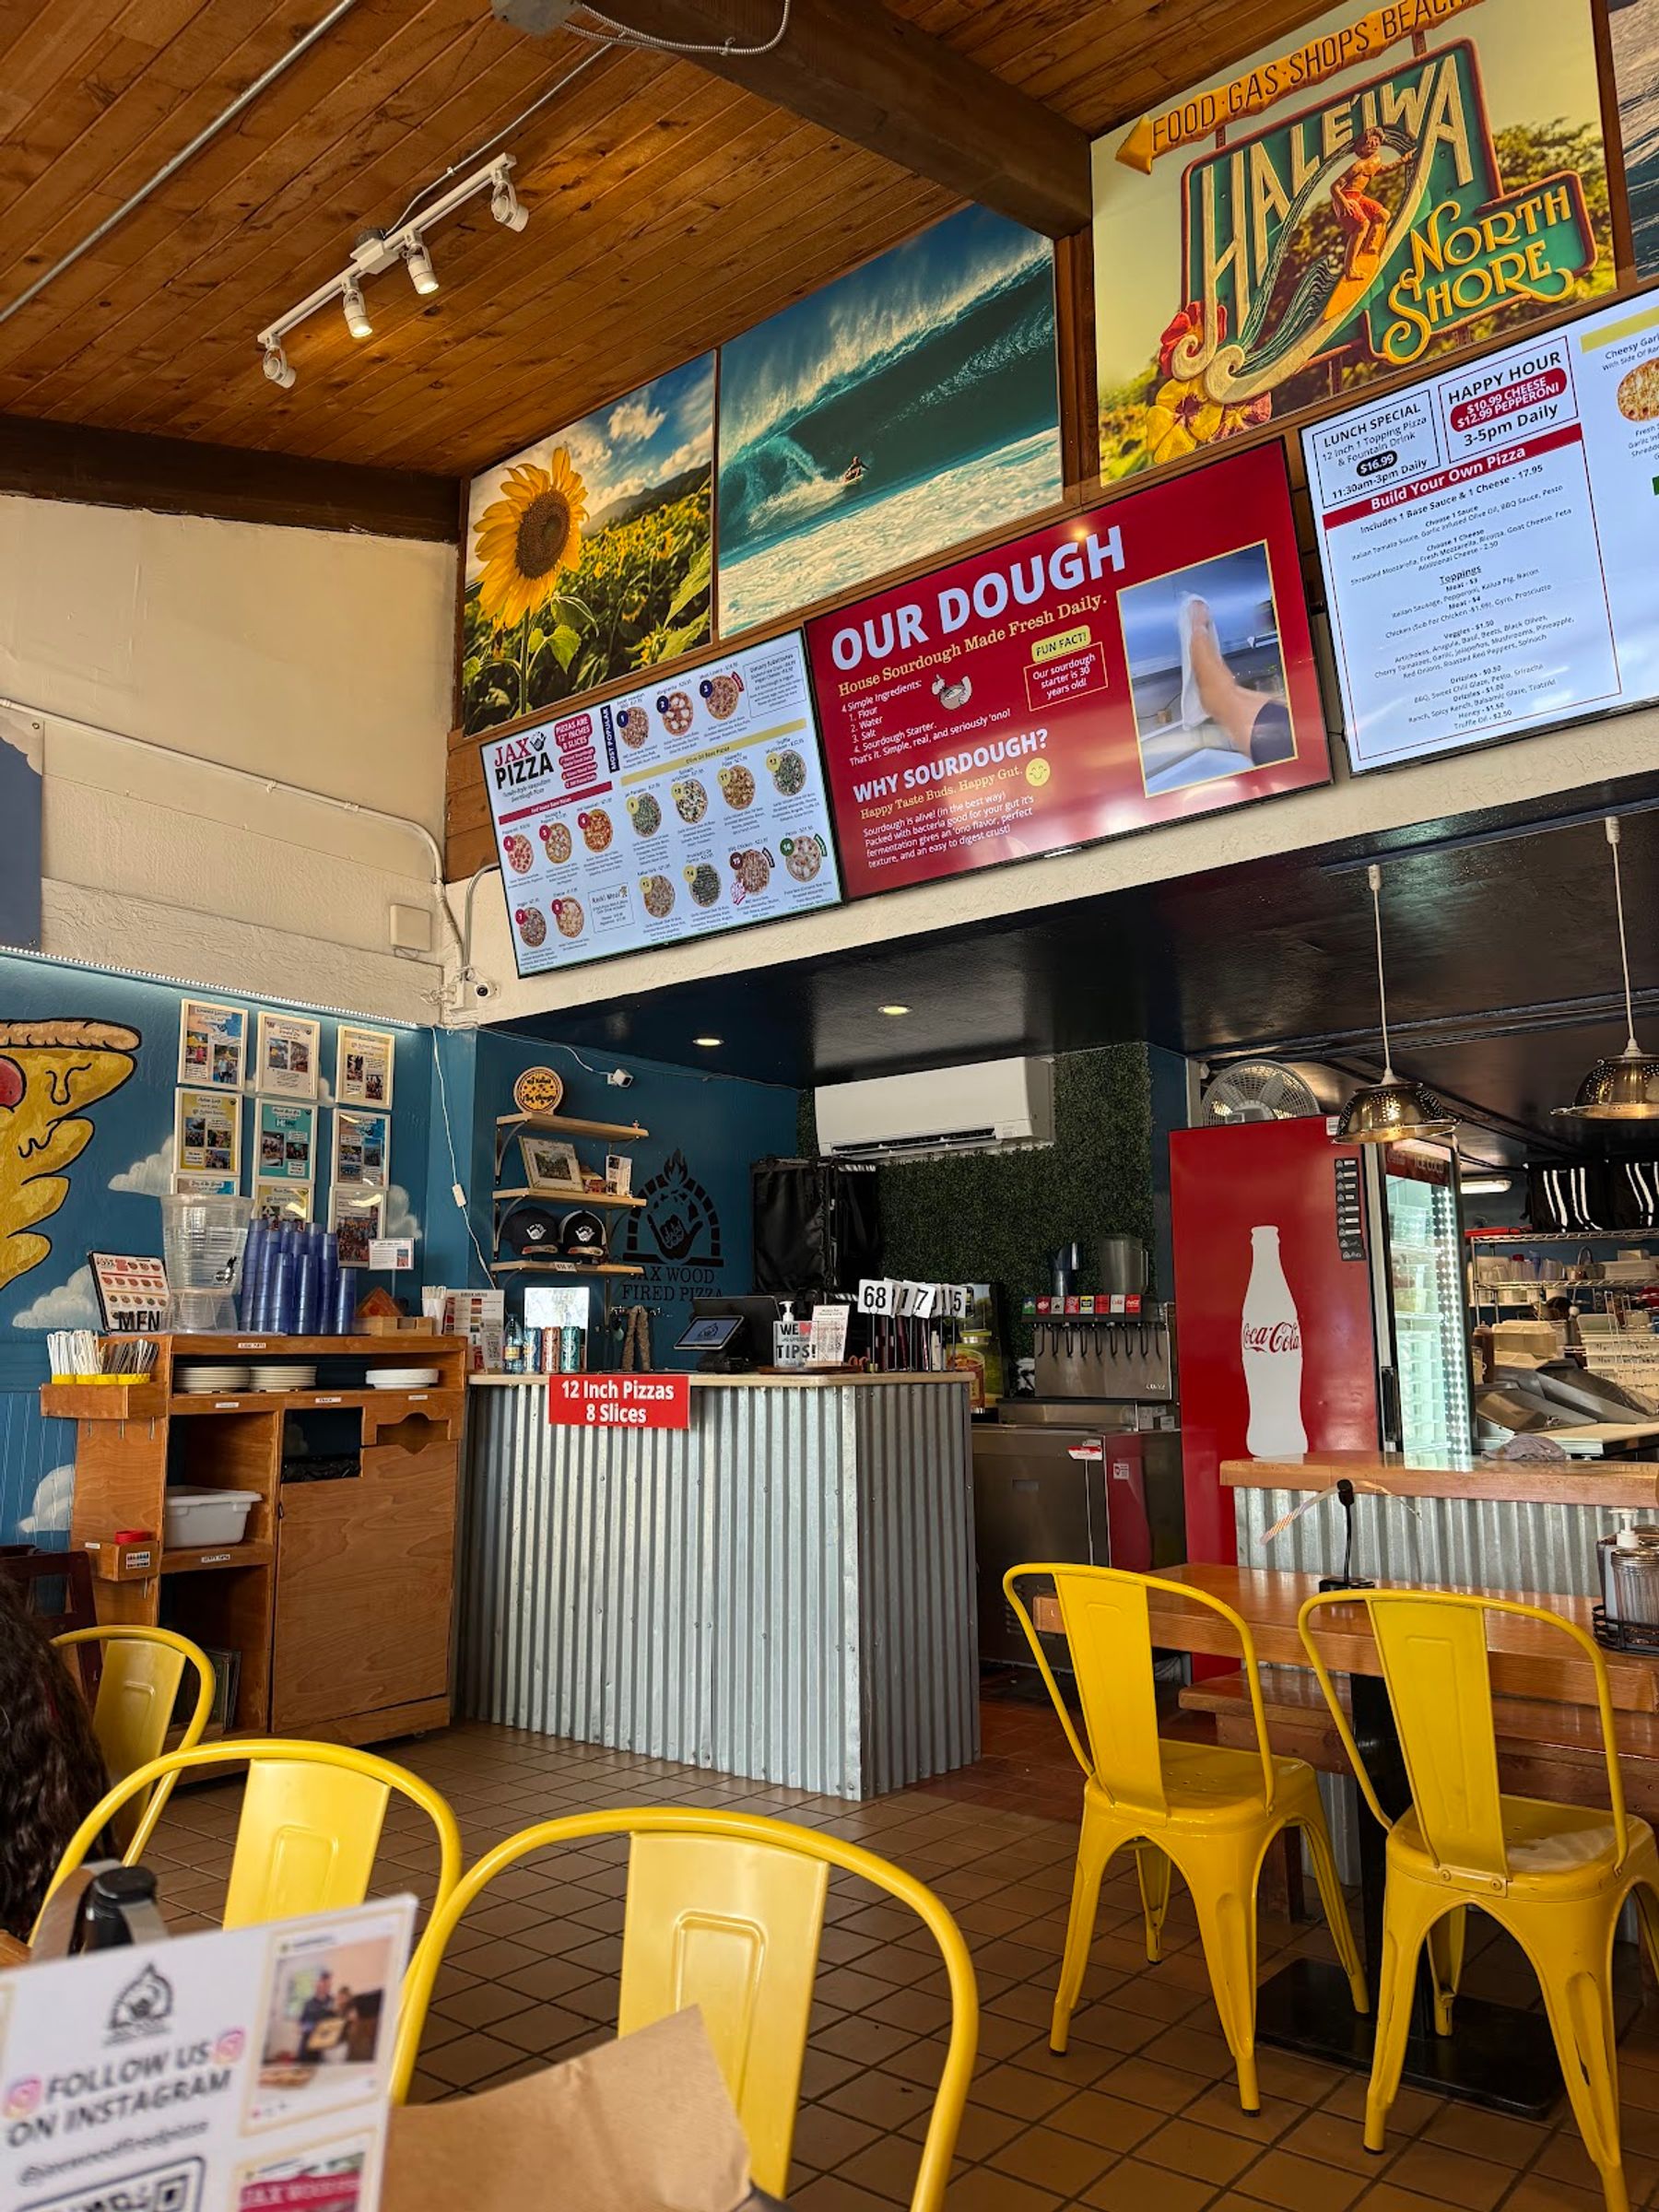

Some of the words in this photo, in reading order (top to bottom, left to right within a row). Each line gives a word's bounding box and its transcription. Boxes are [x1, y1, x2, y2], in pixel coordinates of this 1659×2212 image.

[1152, 94, 1216, 151] FOOD
[1228, 65, 1278, 113] GAS
[1289, 21, 1371, 84] SHOPS
[1382, 0, 1467, 40] BEA
[1400, 185, 1572, 290] NORTH
[1383, 240, 1574, 364] SHORE
[1605, 341, 1637, 361] Cheesy
[1449, 372, 1504, 404] HAPPY
[1510, 351, 1560, 381] HOUR
[1466, 393, 1501, 414] $10.99
[1504, 376, 1547, 400] CHEESE
[1457, 406, 1492, 428] $12.99
[1495, 382, 1559, 413] PEPPERONI
[1322, 451, 1333, 462] 12
[1356, 440, 1360, 449] 1
[1364, 425, 1400, 448] Topping
[1403, 415, 1426, 430] Pizza
[1324, 423, 1366, 447] LUNCH
[1370, 402, 1420, 429] SPECIAL
[1464, 418, 1512, 449] 3-5pm
[1517, 401, 1558, 429] Daily
[1337, 457, 1345, 466] &
[1347, 441, 1387, 463] Fountain
[1390, 431, 1415, 447] Drink
[1359, 453, 1394, 474] $16.99
[1333, 469, 1398, 500] 11:30am-3pm
[1401, 457, 1427, 476] Daily
[1371, 487, 1406, 510] Build
[1410, 474, 1444, 496] Your
[1448, 460, 1483, 482] Own
[1487, 444, 1525, 468] Pizza
[1360, 515, 1396, 534] Includes
[1399, 512, 1404, 520] 1
[1406, 504, 1428, 517] Base
[1430, 494, 1457, 510] Sauce
[1458, 490, 1465, 500] &
[1468, 488, 1473, 496] 1
[1476, 476, 1510, 493] Cheese
[1518, 464, 1542, 478] 17.95
[1439, 564, 1481, 585] Toppings
[830, 601, 928, 672] OUR
[938, 527, 1124, 631] DOUGH
[838, 671, 879, 697] House
[883, 642, 961, 683] Sourdough
[964, 626, 1005, 652] Made
[1008, 608, 1053, 636] Fresh
[1057, 590, 1107, 622] Daily.
[1036, 641, 1056, 656] FUN
[1059, 630, 1086, 648] FACT!
[1031, 667, 1049, 680] Our
[1050, 652, 1095, 676] sourdough
[1041, 672, 1069, 688] starter
[1070, 668, 1077, 678] is
[1078, 665, 1090, 676] 30
[841, 703, 846, 713] 4
[847, 695, 873, 712] Simple
[875, 678, 922, 703] Ingredients:
[1046, 684, 1069, 700] years
[601, 707, 616, 748] POPULAR
[857, 705, 877, 719] Flour
[859, 714, 883, 729] Water
[568, 724, 590, 738] INCHES
[568, 735, 587, 747] SLICES
[849, 751, 872, 767] That's
[912, 734, 931, 747] real,
[932, 727, 948, 740] and
[949, 715, 987, 735] seriously
[861, 727, 877, 740] Salt
[863, 730, 905, 752] Sourdough
[906, 720, 936, 737] Starter.
[492, 736, 531, 766] JAX
[607, 747, 619, 771] MOST
[853, 773, 900, 803] WHY
[903, 729, 1048, 787] SOURDOUGH?
[495, 751, 553, 788] PIZZA
[860, 801, 893, 820] Happy
[894, 792, 924, 809] Taste
[959, 771, 995, 793] Happy
[997, 763, 1022, 780] Gut.
[863, 818, 905, 838] Sourdough
[906, 816, 912, 825] is
[949, 801, 963, 813] the
[964, 795, 982, 808] best
[865, 832, 892, 847] Packed
[893, 827, 912, 840] with
[912, 818, 945, 834] bacteria
[946, 812, 968, 827] good
[969, 807, 982, 819] for
[982, 804, 1004, 817] your
[1004, 799, 1019, 813] gut
[866, 837, 917, 857] fermentation
[918, 832, 939, 845] gives
[940, 829, 952, 838] an
[1001, 806, 1032, 823] perfect
[899, 849, 915, 860] and
[916, 847, 927, 856] an
[928, 841, 947, 854] easy
[947, 838, 958, 847] to
[959, 830, 984, 846] digest
[620, 1284, 676, 1302] FIRED
[679, 1285, 724, 1302] PIZZA
[667, 1267, 715, 1284] WOOD
[864, 1285, 887, 1309] 68
[780, 1323, 799, 1335] WE
[1243, 1322, 1300, 1353] Coca-Cola
[776, 1345, 818, 1359] TIPS!
[560, 1380, 580, 1399] 12
[583, 1380, 618, 1399] Inch
[623, 1380, 675, 1400] Pizzas
[586, 1403, 596, 1422] 8
[599, 1402, 647, 1423] Slices
[47, 2051, 170, 2102] FOLLOW
[176, 2041, 212, 2070] US
[7, 2112, 56, 2148] ON
[64, 2069, 232, 2134] INSTAGRAM
